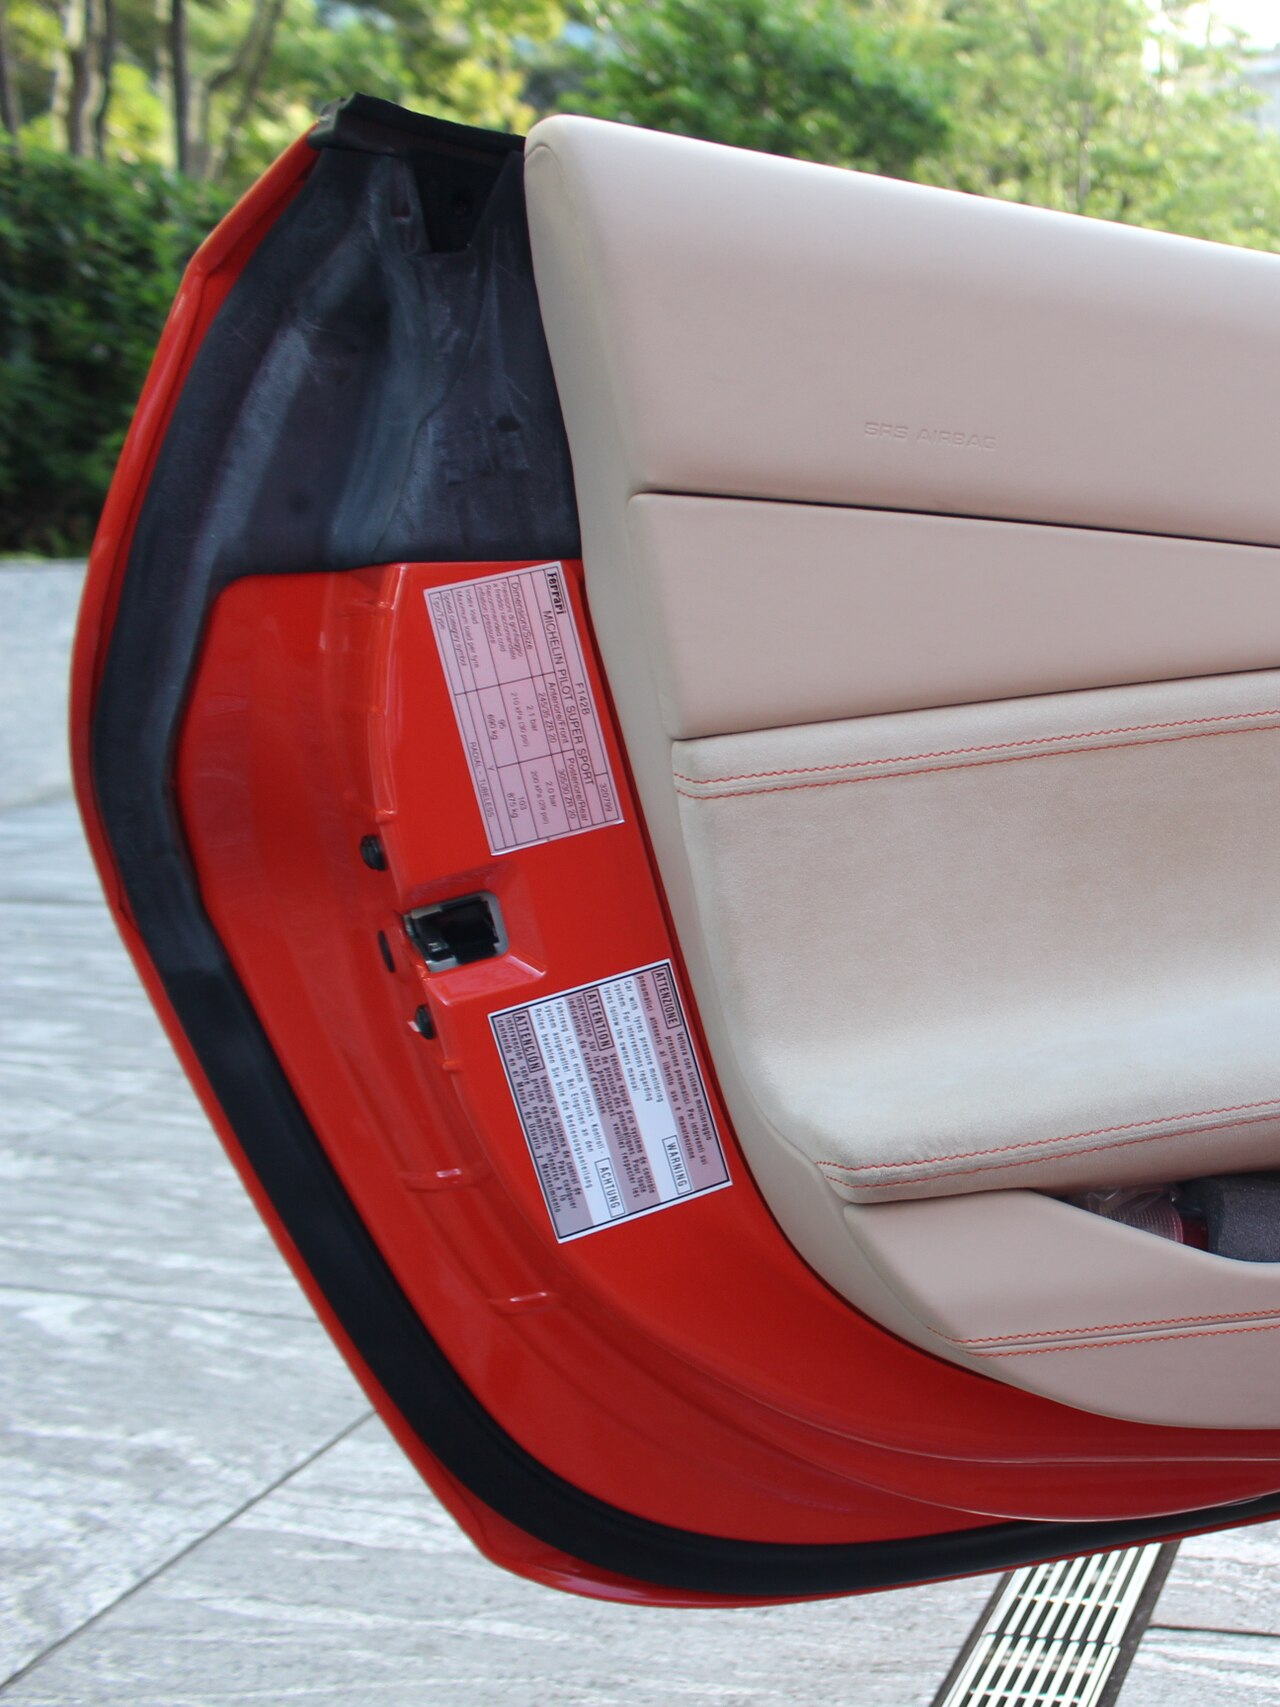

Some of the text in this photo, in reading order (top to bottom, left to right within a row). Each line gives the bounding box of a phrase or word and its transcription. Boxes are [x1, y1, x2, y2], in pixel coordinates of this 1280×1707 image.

[864, 421, 997, 449] SRS AIRBAG
[546, 571, 565, 615] Ferrari
[510, 582, 534, 650] Dimensioni/Size
[537, 691, 550, 718] 245/35
[542, 609, 593, 786] MICHELIN PILOT SUPER SPORT
[547, 681, 569, 743] Anteriore/Front
[574, 682, 589, 715] F142B
[529, 718, 538, 731] bar
[469, 741, 494, 817] RADIAL TUBELESS
[548, 794, 557, 807] bar
[566, 757, 588, 821] Posteriore/Rear
[599, 782, 612, 812] 320799
[541, 1004, 557, 1029] system
[601, 986, 614, 1004] tyres
[654, 970, 678, 1025] ATTENZIONE
[514, 1013, 542, 1070] ATTENCIÓN
[566, 997, 584, 1037] indications
[582, 1051, 595, 1075] carnet
[586, 992, 610, 1047] ATTENTION
[615, 1028, 624, 1039] the
[623, 980, 665, 1103] Car with tyres pressure monitoring
[636, 974, 653, 1012] pneumatici
[649, 1016, 663, 1045] attenersi
[662, 1061, 674, 1086] libretto
[552, 1001, 570, 1033] Fahrzeug
[572, 1062, 585, 1083] einem
[619, 1041, 630, 1065] owners
[621, 1010, 654, 1102] For interventions regarding
[664, 1035, 680, 1067] pressione
[515, 1081, 529, 1107] Manual
[574, 995, 593, 1038] intervention
[587, 1040, 596, 1053] sur
[619, 1151, 636, 1185] respecter
[676, 1031, 712, 1141] Vettura con sistema monitoraggio
[553, 1121, 567, 1147] sistema
[602, 1066, 618, 1096] pression
[631, 1159, 641, 1174] Pour
[686, 1108, 695, 1120] Per
[690, 1121, 704, 1153] interventi
[556, 1160, 567, 1177] Para
[666, 1141, 687, 1187] WARNING
[599, 1165, 619, 1209] ACHTUNG
